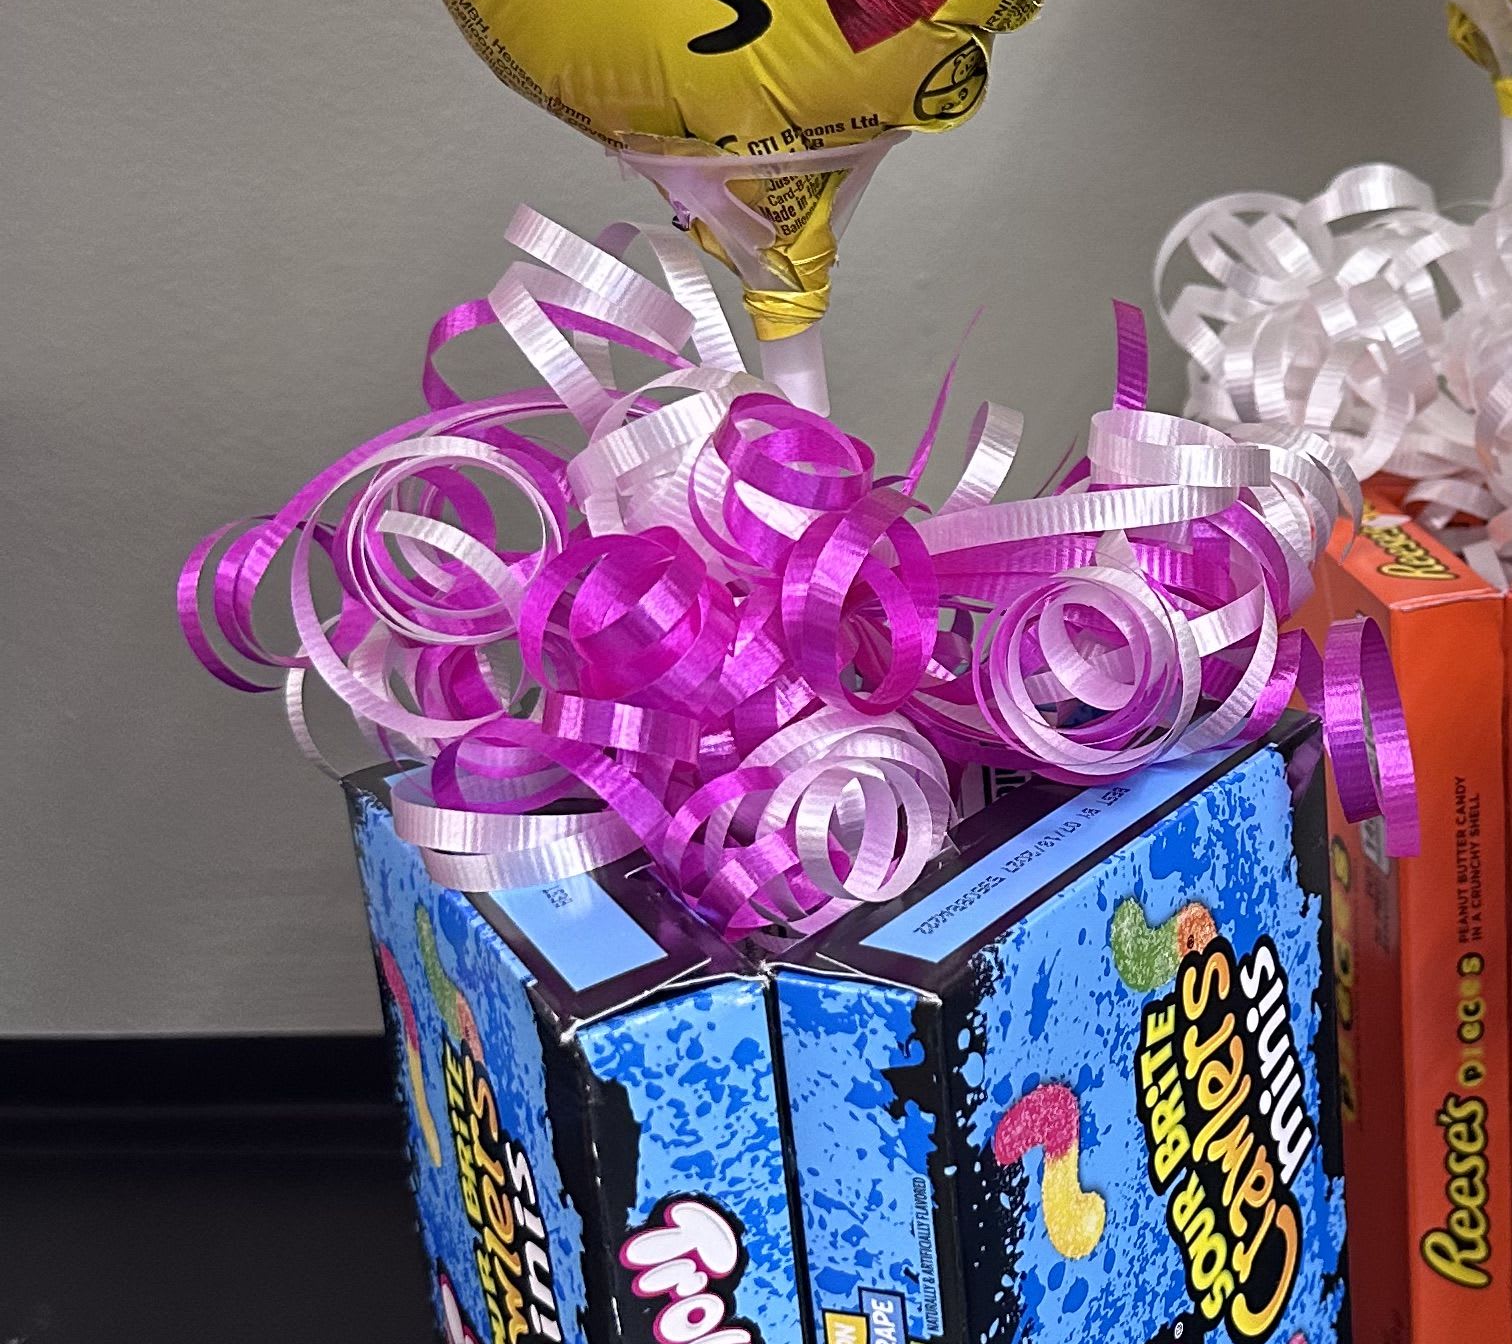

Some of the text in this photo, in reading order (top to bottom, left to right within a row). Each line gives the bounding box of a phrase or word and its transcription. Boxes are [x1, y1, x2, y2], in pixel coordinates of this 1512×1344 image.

[747, 136, 778, 156] CTI
[1469, 792, 1480, 837] SHELL
[1455, 776, 1469, 944] PEANUT BUTTER CANDY
[1470, 842, 1482, 909] CRUNCHY
[1240, 945, 1312, 1184] minis
[1182, 950, 1299, 1337] Crawlers
[913, 1176, 930, 1221] FLAVORED
[1421, 1091, 1492, 1289] Reese's
[917, 1220, 934, 1276] ARTIFICIALLY
[1171, 1169, 1235, 1320] SOUR
[923, 1283, 939, 1332] NATURALLY
